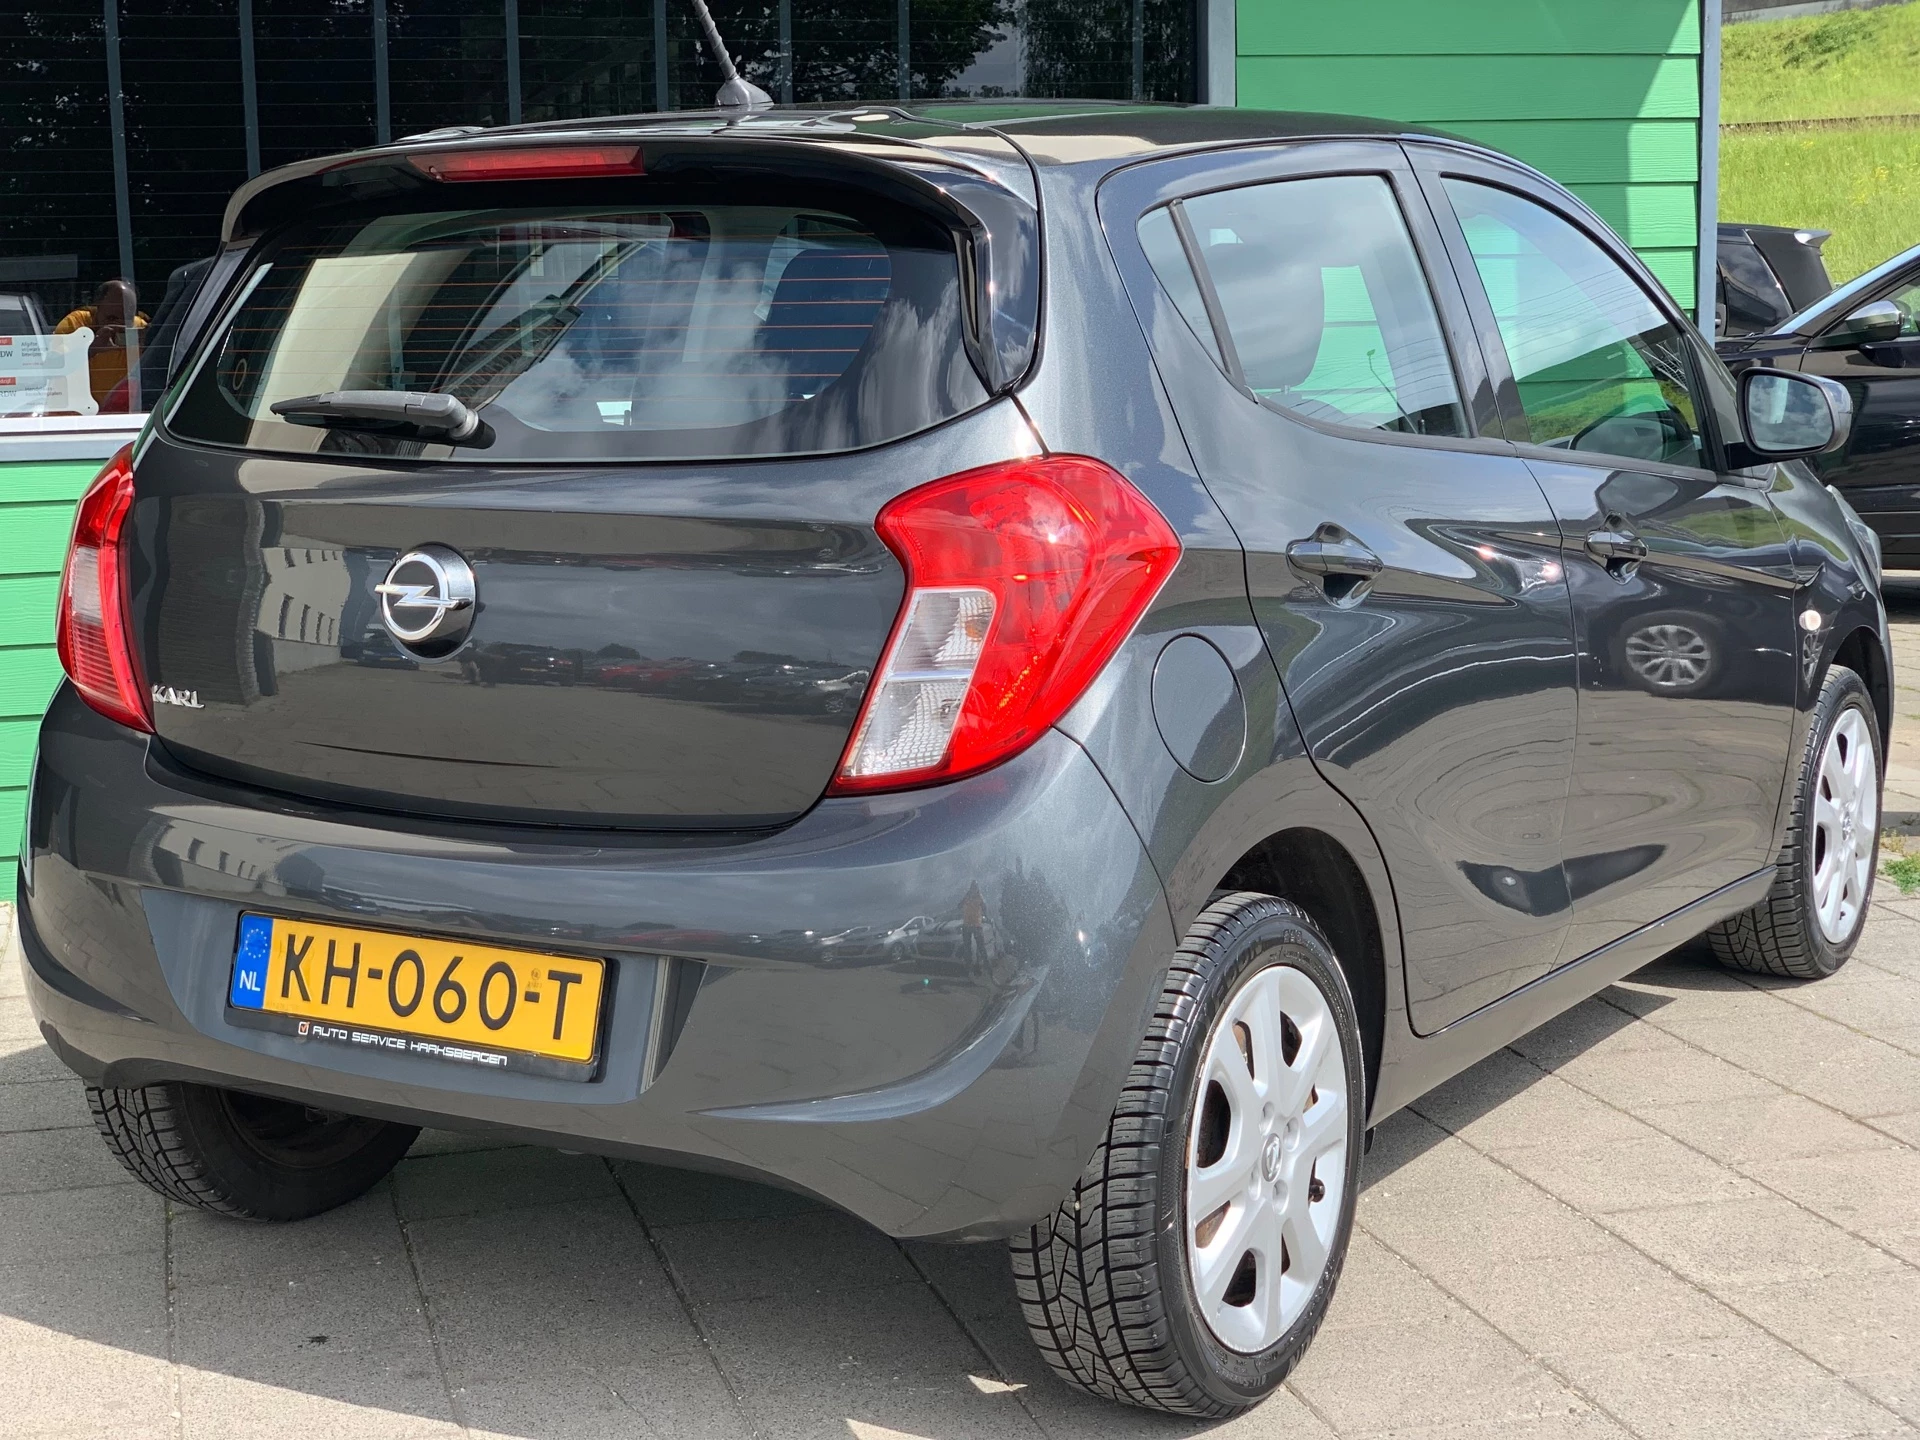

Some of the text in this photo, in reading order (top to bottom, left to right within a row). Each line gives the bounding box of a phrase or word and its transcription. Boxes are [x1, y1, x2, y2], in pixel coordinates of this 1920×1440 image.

[152, 684, 205, 709] KARL
[239, 969, 261, 992] NL
[281, 933, 583, 1041] KH-060-T
[312, 1025, 508, 1067] AUTO SERVICE HAAKSBERGEN
